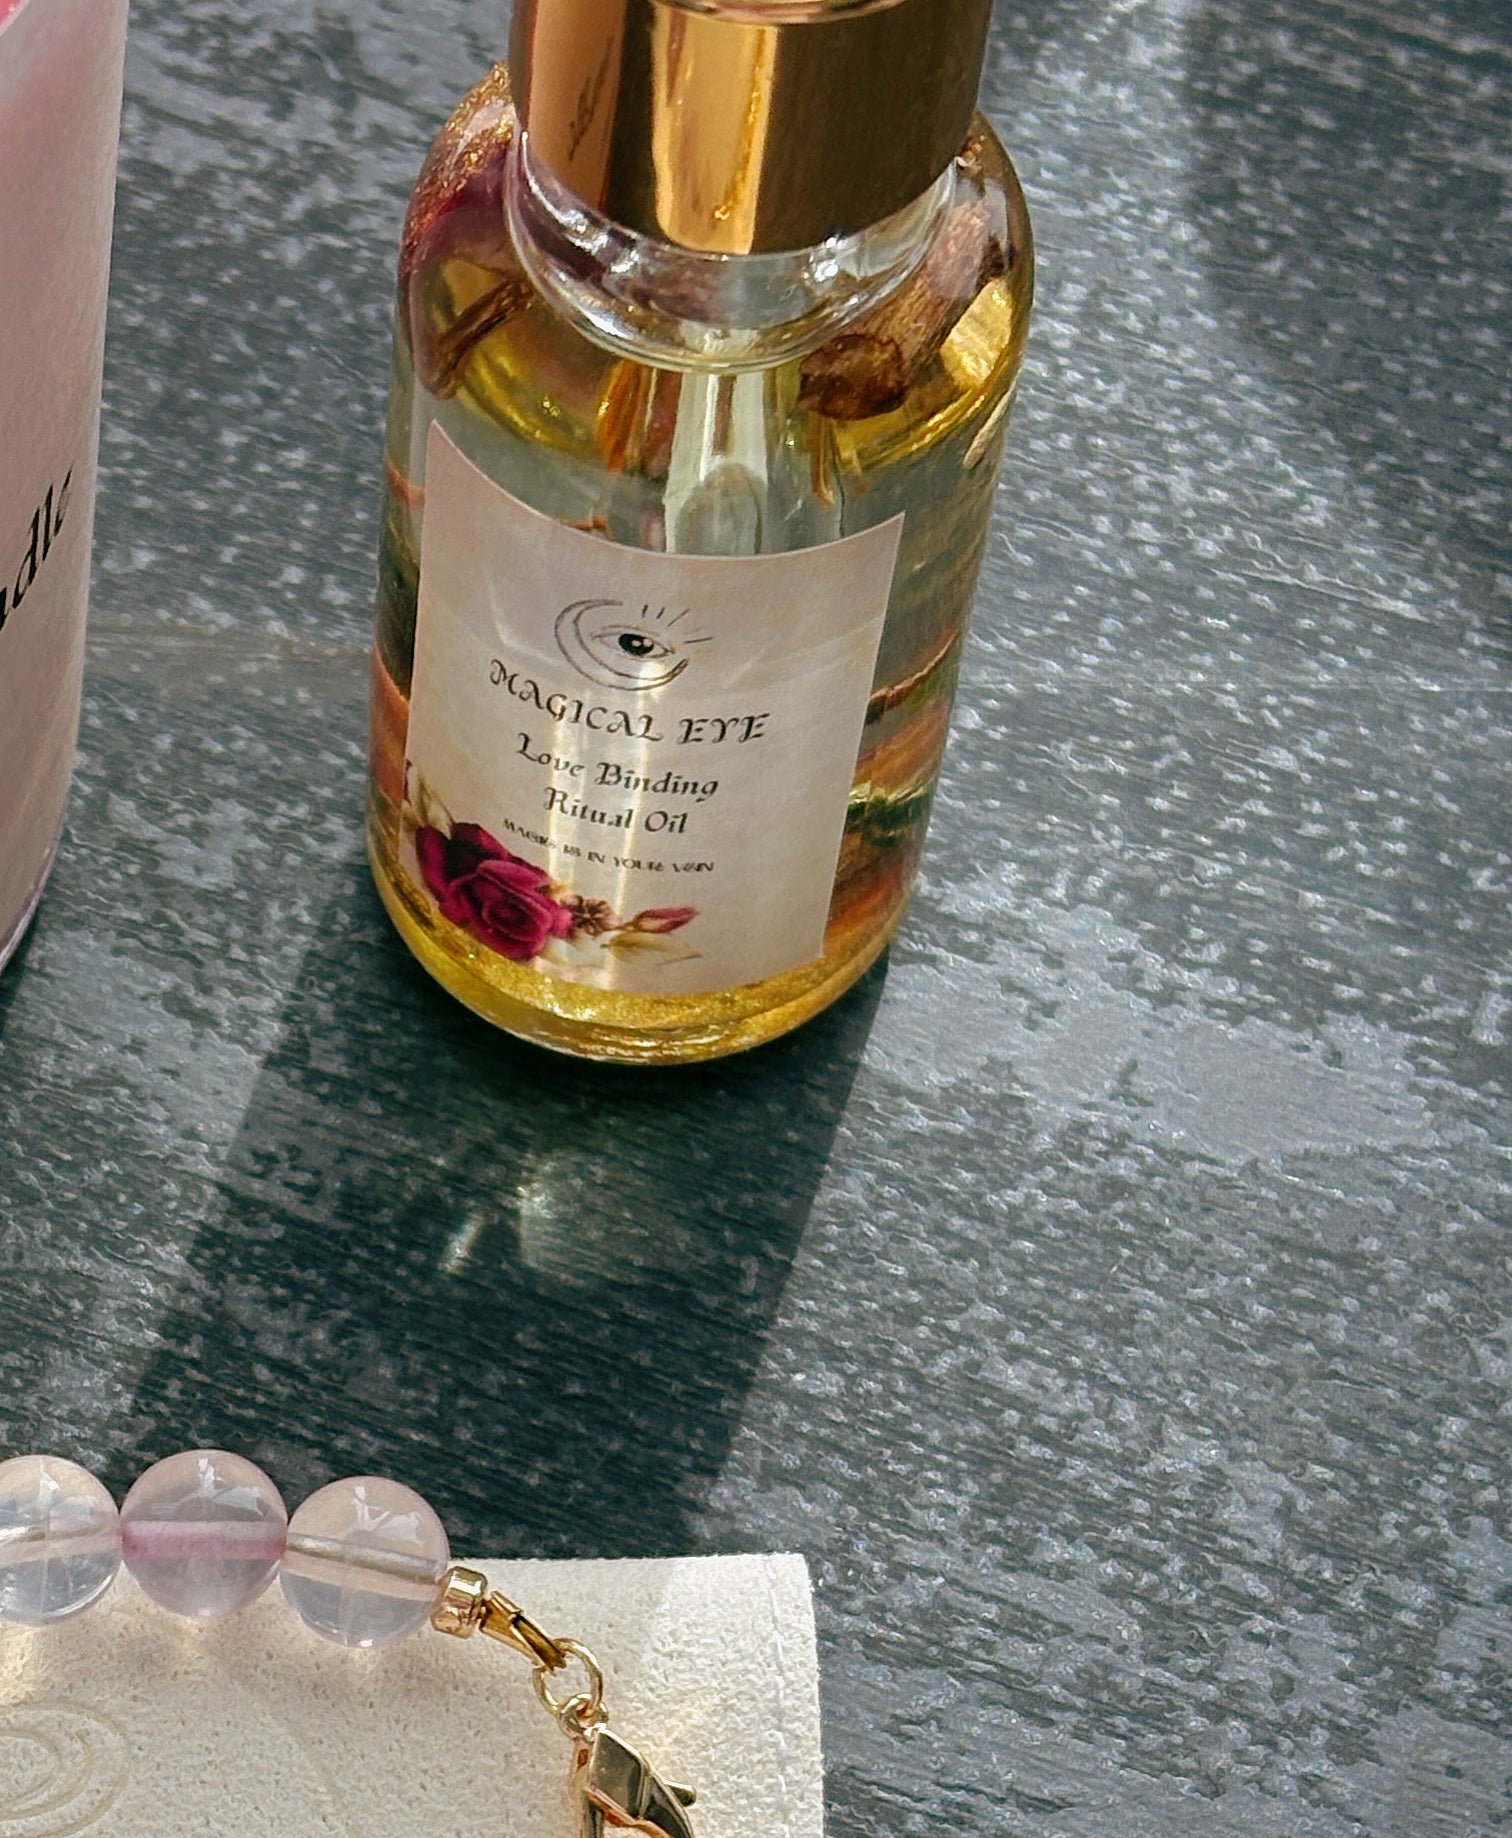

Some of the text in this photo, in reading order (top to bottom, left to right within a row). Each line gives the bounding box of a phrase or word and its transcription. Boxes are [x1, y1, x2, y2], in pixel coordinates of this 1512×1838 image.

[489, 658, 771, 745] MAGICAL EYE
[515, 732, 718, 803] Love Binding
[543, 786, 689, 835] Ritual Oil
[588, 850, 606, 864] IN
